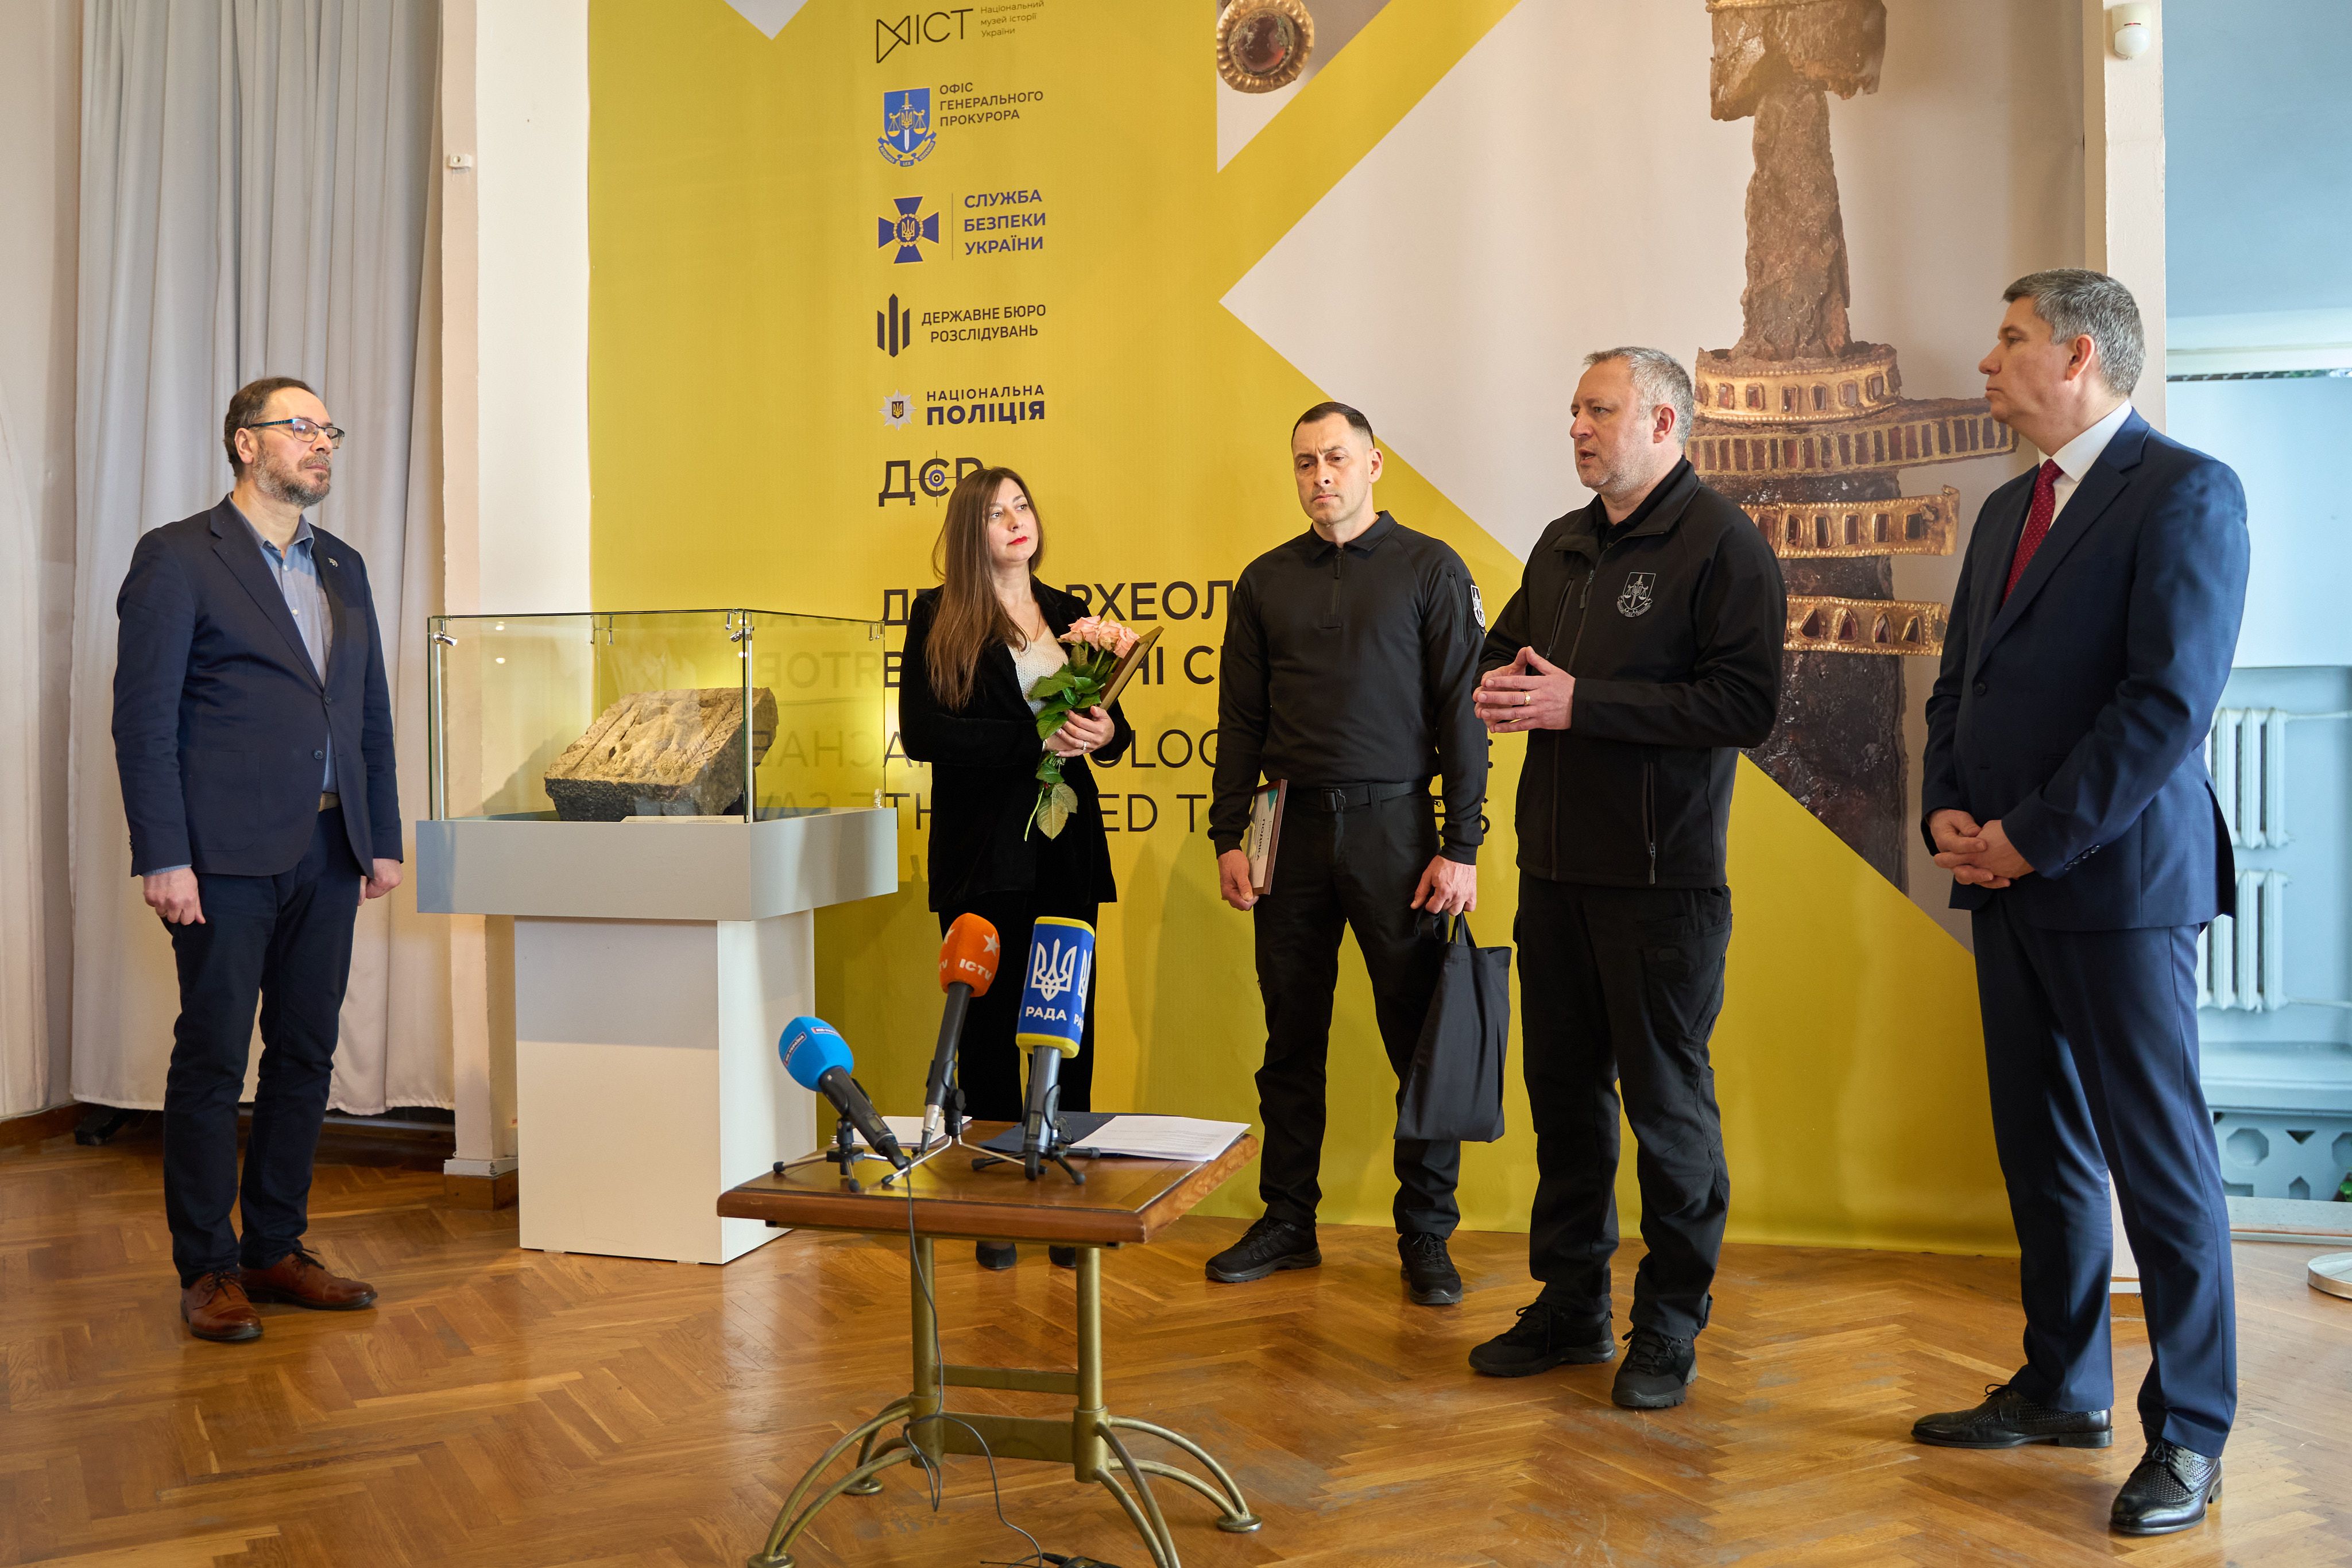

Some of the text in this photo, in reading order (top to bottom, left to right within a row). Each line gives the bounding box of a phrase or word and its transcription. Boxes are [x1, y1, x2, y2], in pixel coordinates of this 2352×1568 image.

[980, 1, 1044, 14] Національний
[980, 13, 1037, 26] музей історії
[981, 28, 1015, 38] України
[939, 82, 973, 95] ОФІС
[940, 91, 1043, 111] ГЕНЕРАЛЬНОГО
[940, 109, 1020, 127] ПРОКУРОРА
[964, 189, 1042, 208] СЛУЖБА
[964, 212, 1046, 232] БЕЗПЕКИ
[965, 236, 1043, 255] УКРАЇНИ
[922, 304, 1046, 326] ДЕРЖАВНЕ БЮРО
[930, 324, 1038, 343] РОЗСЛІДУВАНЬ
[927, 385, 1045, 401] НАЦІОНАЛЬНА
[927, 401, 1045, 425] ПОЛІЦІЯ
[959, 958, 992, 981] ICTV
[1025, 1006, 1067, 1021] РАДА
